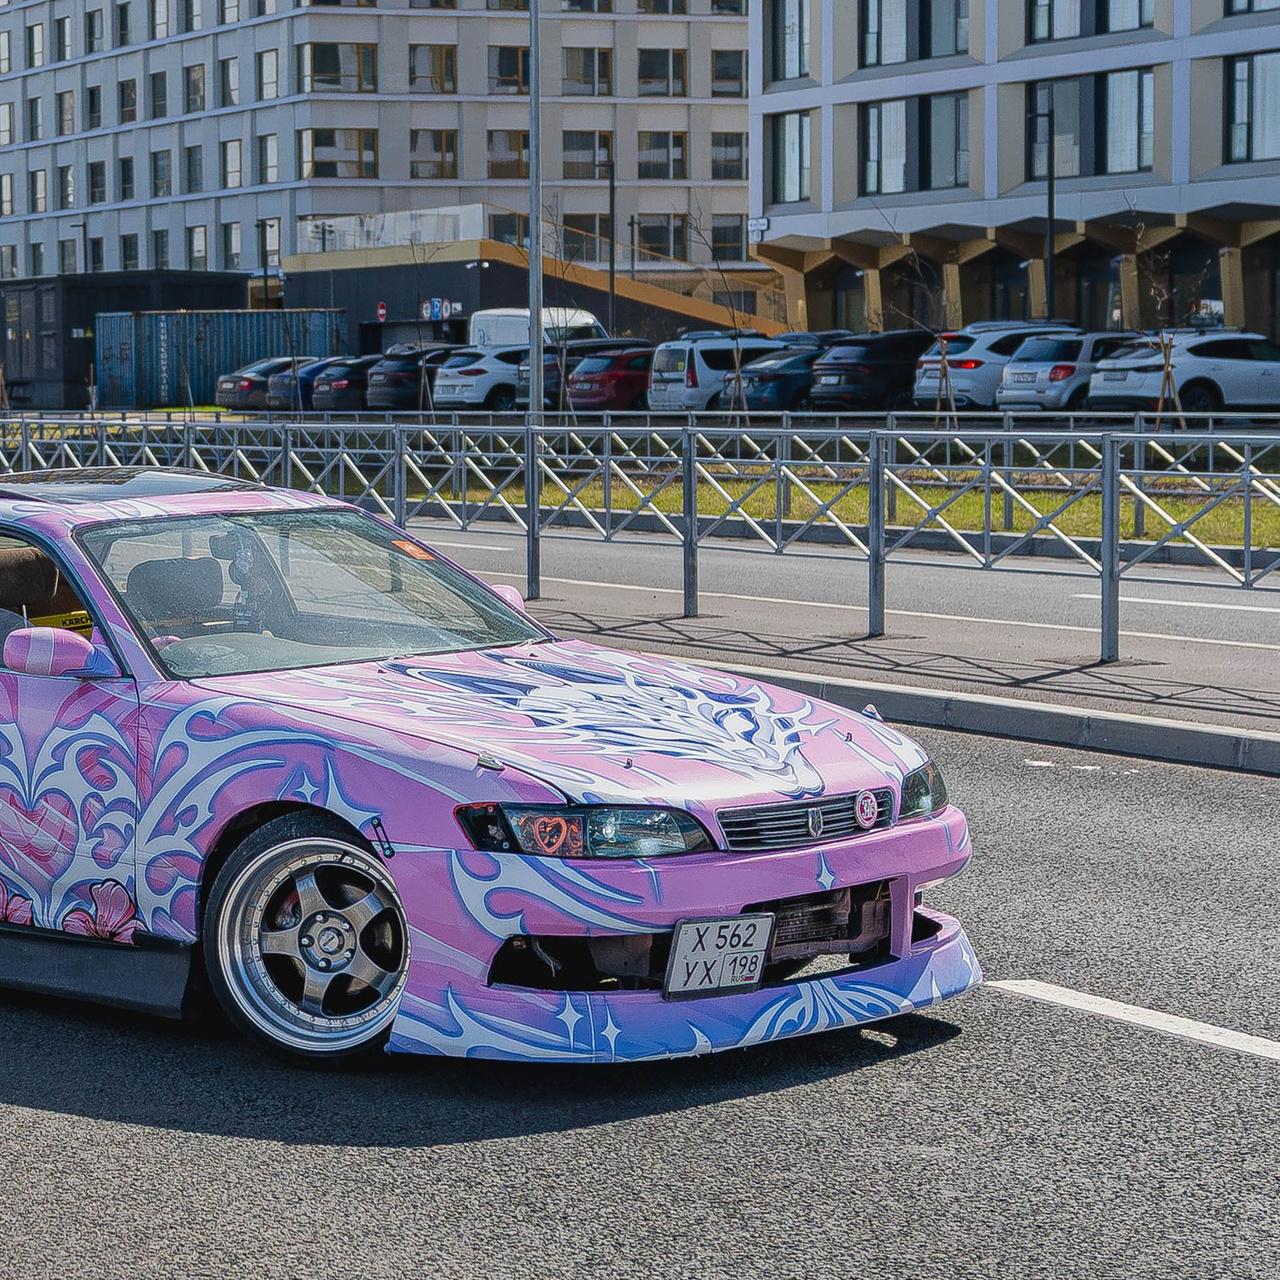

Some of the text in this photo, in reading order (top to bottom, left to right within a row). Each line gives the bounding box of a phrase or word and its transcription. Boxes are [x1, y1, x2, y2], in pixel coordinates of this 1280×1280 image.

[715, 922, 757, 950] 562
[728, 954, 759, 976] 198
[730, 974, 745, 983] RUS
